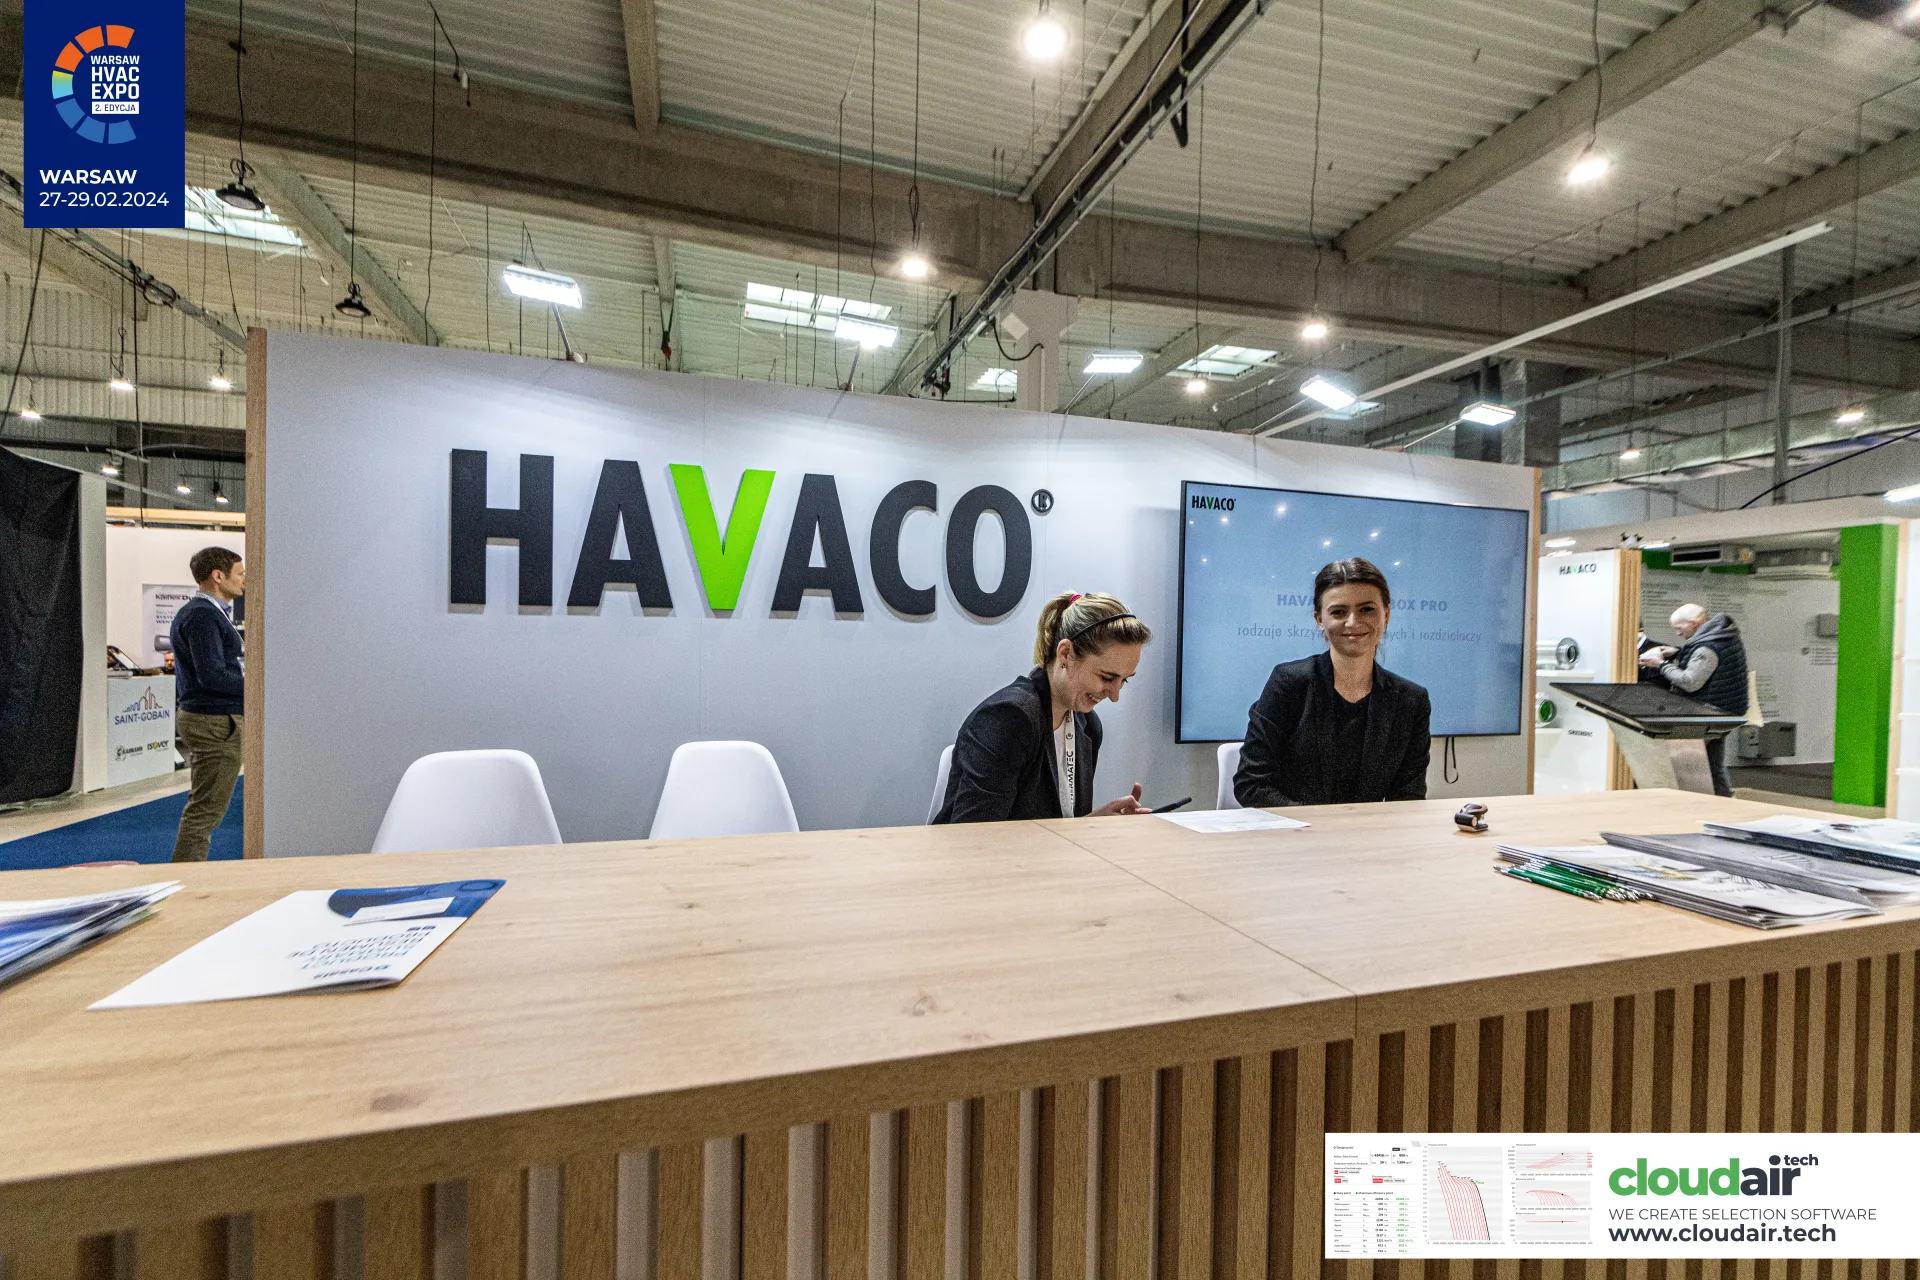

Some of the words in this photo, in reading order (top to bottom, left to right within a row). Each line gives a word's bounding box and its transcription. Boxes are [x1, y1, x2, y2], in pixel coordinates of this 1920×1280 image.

[1191, 495, 1235, 512] HAVACO
[1420, 600, 1448, 612] PRO
[1237, 622, 1282, 640] rodzaje
[114, 709, 170, 725] SAINT-GOBAIN
